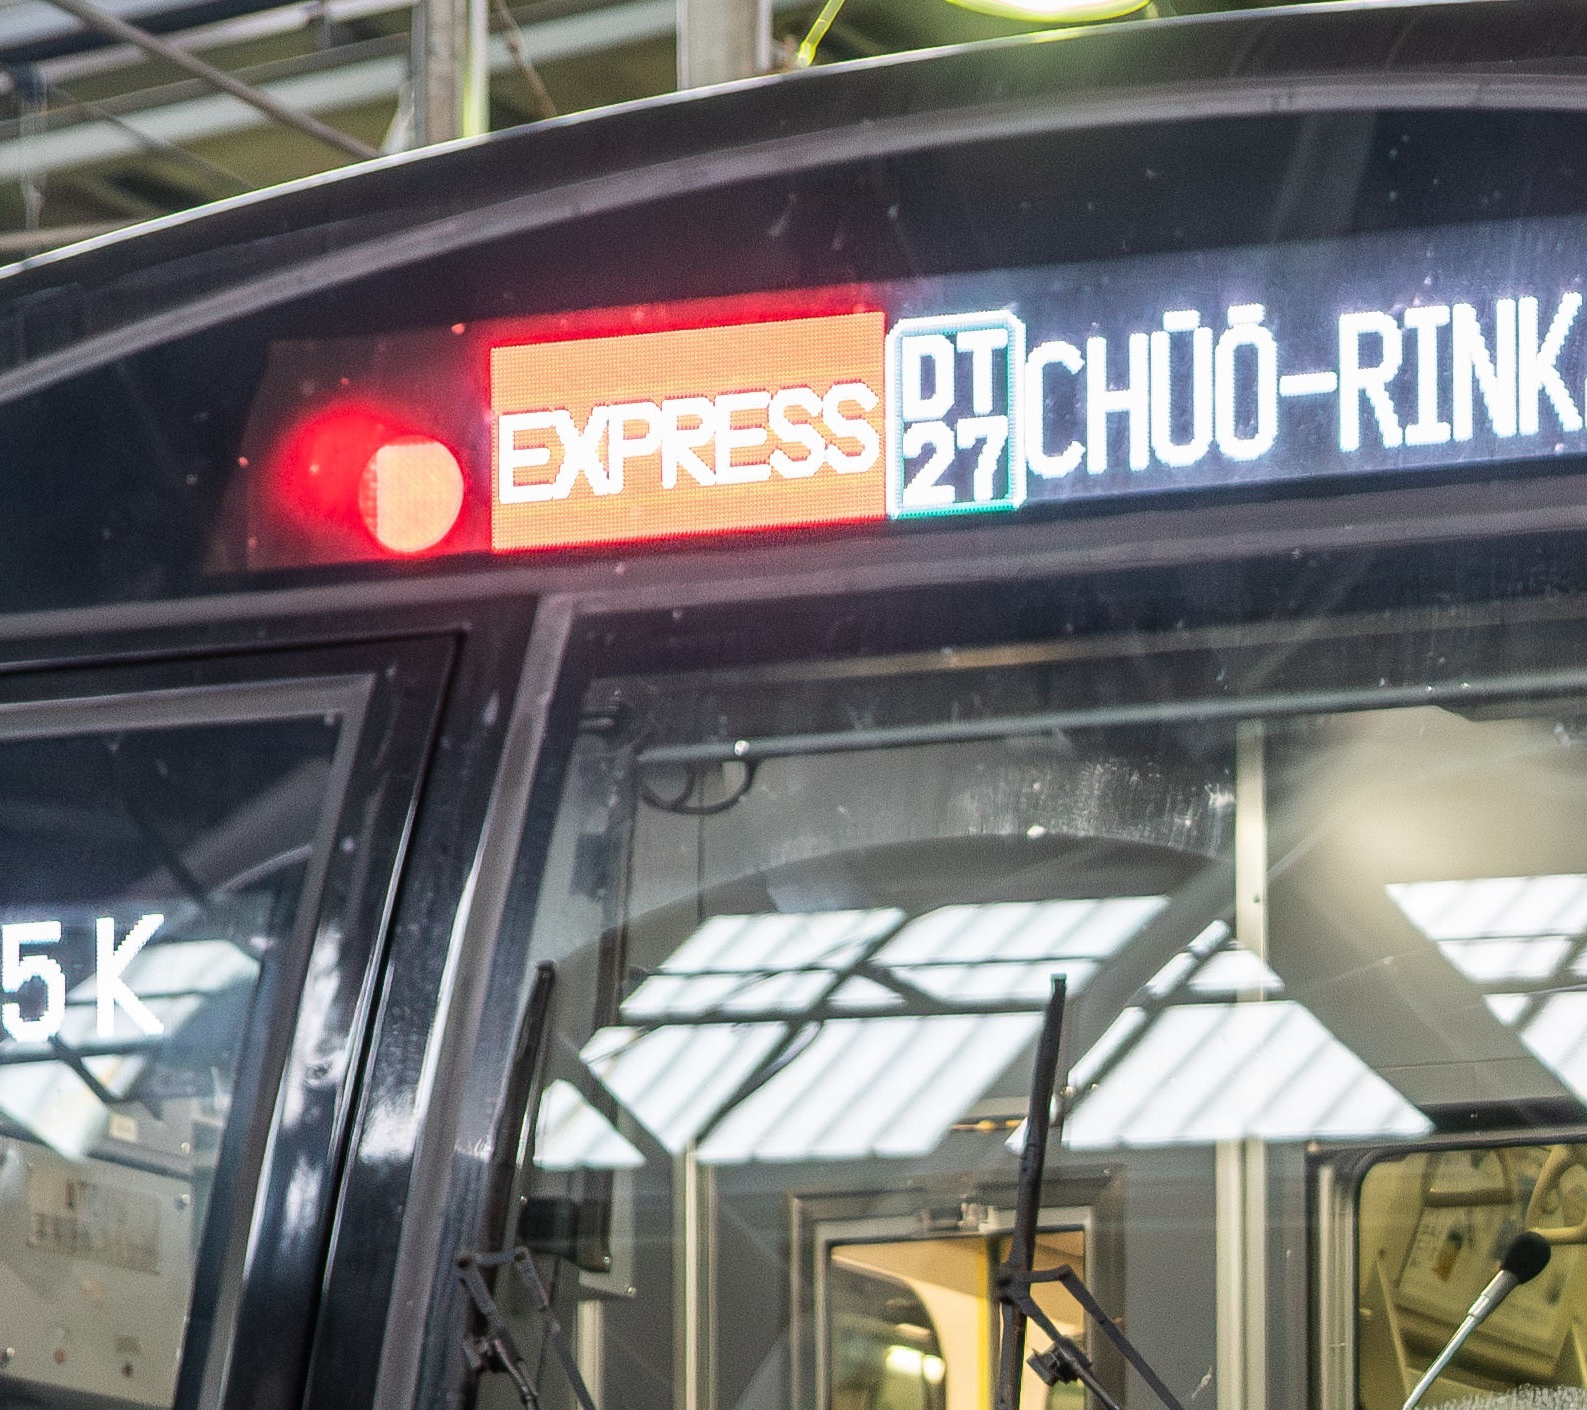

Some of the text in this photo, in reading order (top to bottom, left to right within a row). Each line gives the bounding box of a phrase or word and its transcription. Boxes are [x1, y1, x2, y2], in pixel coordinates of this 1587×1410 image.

[902, 328, 1009, 420] DT
[498, 381, 880, 505] EXPRESS
[902, 415, 1009, 502] 27
